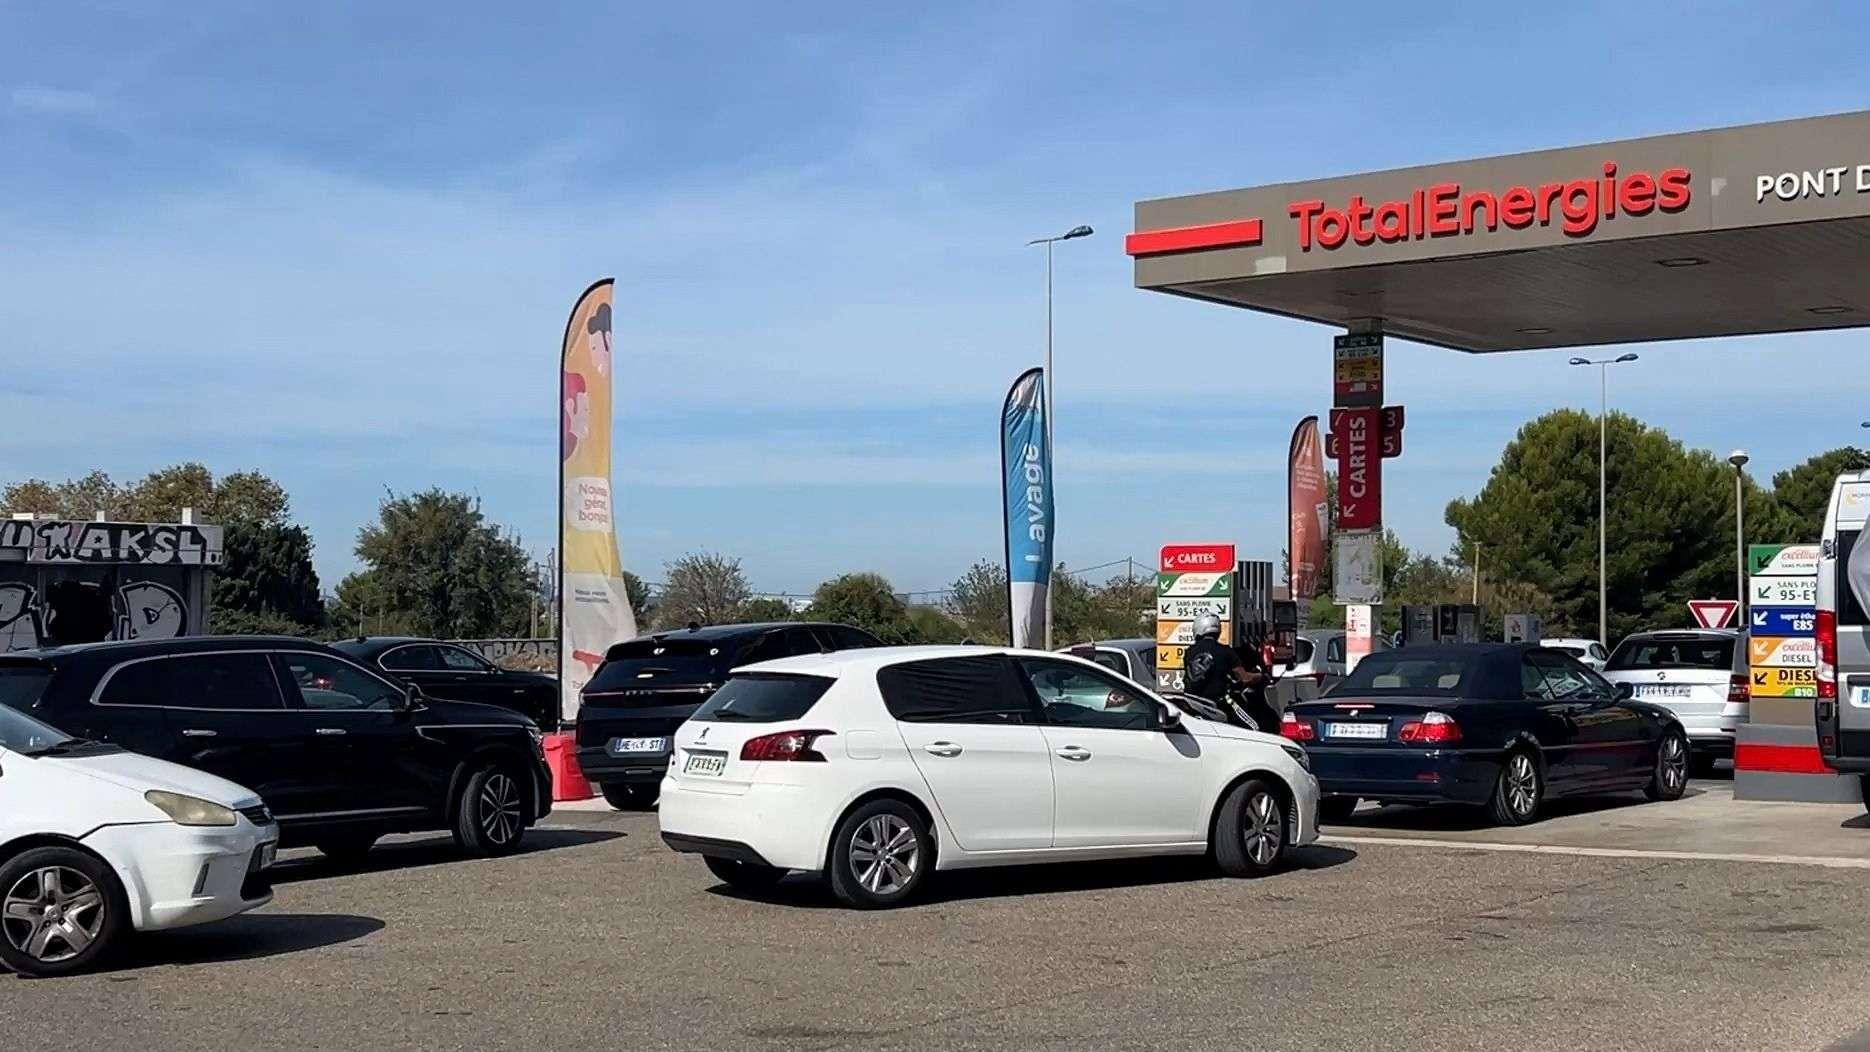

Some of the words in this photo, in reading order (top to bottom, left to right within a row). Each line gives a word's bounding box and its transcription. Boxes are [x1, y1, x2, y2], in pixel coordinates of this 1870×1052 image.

[1757, 166, 1848, 203] PONT
[1287, 161, 1691, 251] TotalEnergies
[1387, 410, 1396, 428] 3
[1383, 436, 1395, 454] 5
[1350, 416, 1367, 498] CARTES
[1024, 442, 1046, 562] lavage
[1177, 552, 1216, 564] CARTES
[1780, 589, 1817, 601] 95-E1
[1793, 620, 1813, 631] E85
[1782, 654, 1812, 663] DIESEL
[1778, 669, 1817, 681] DIES
